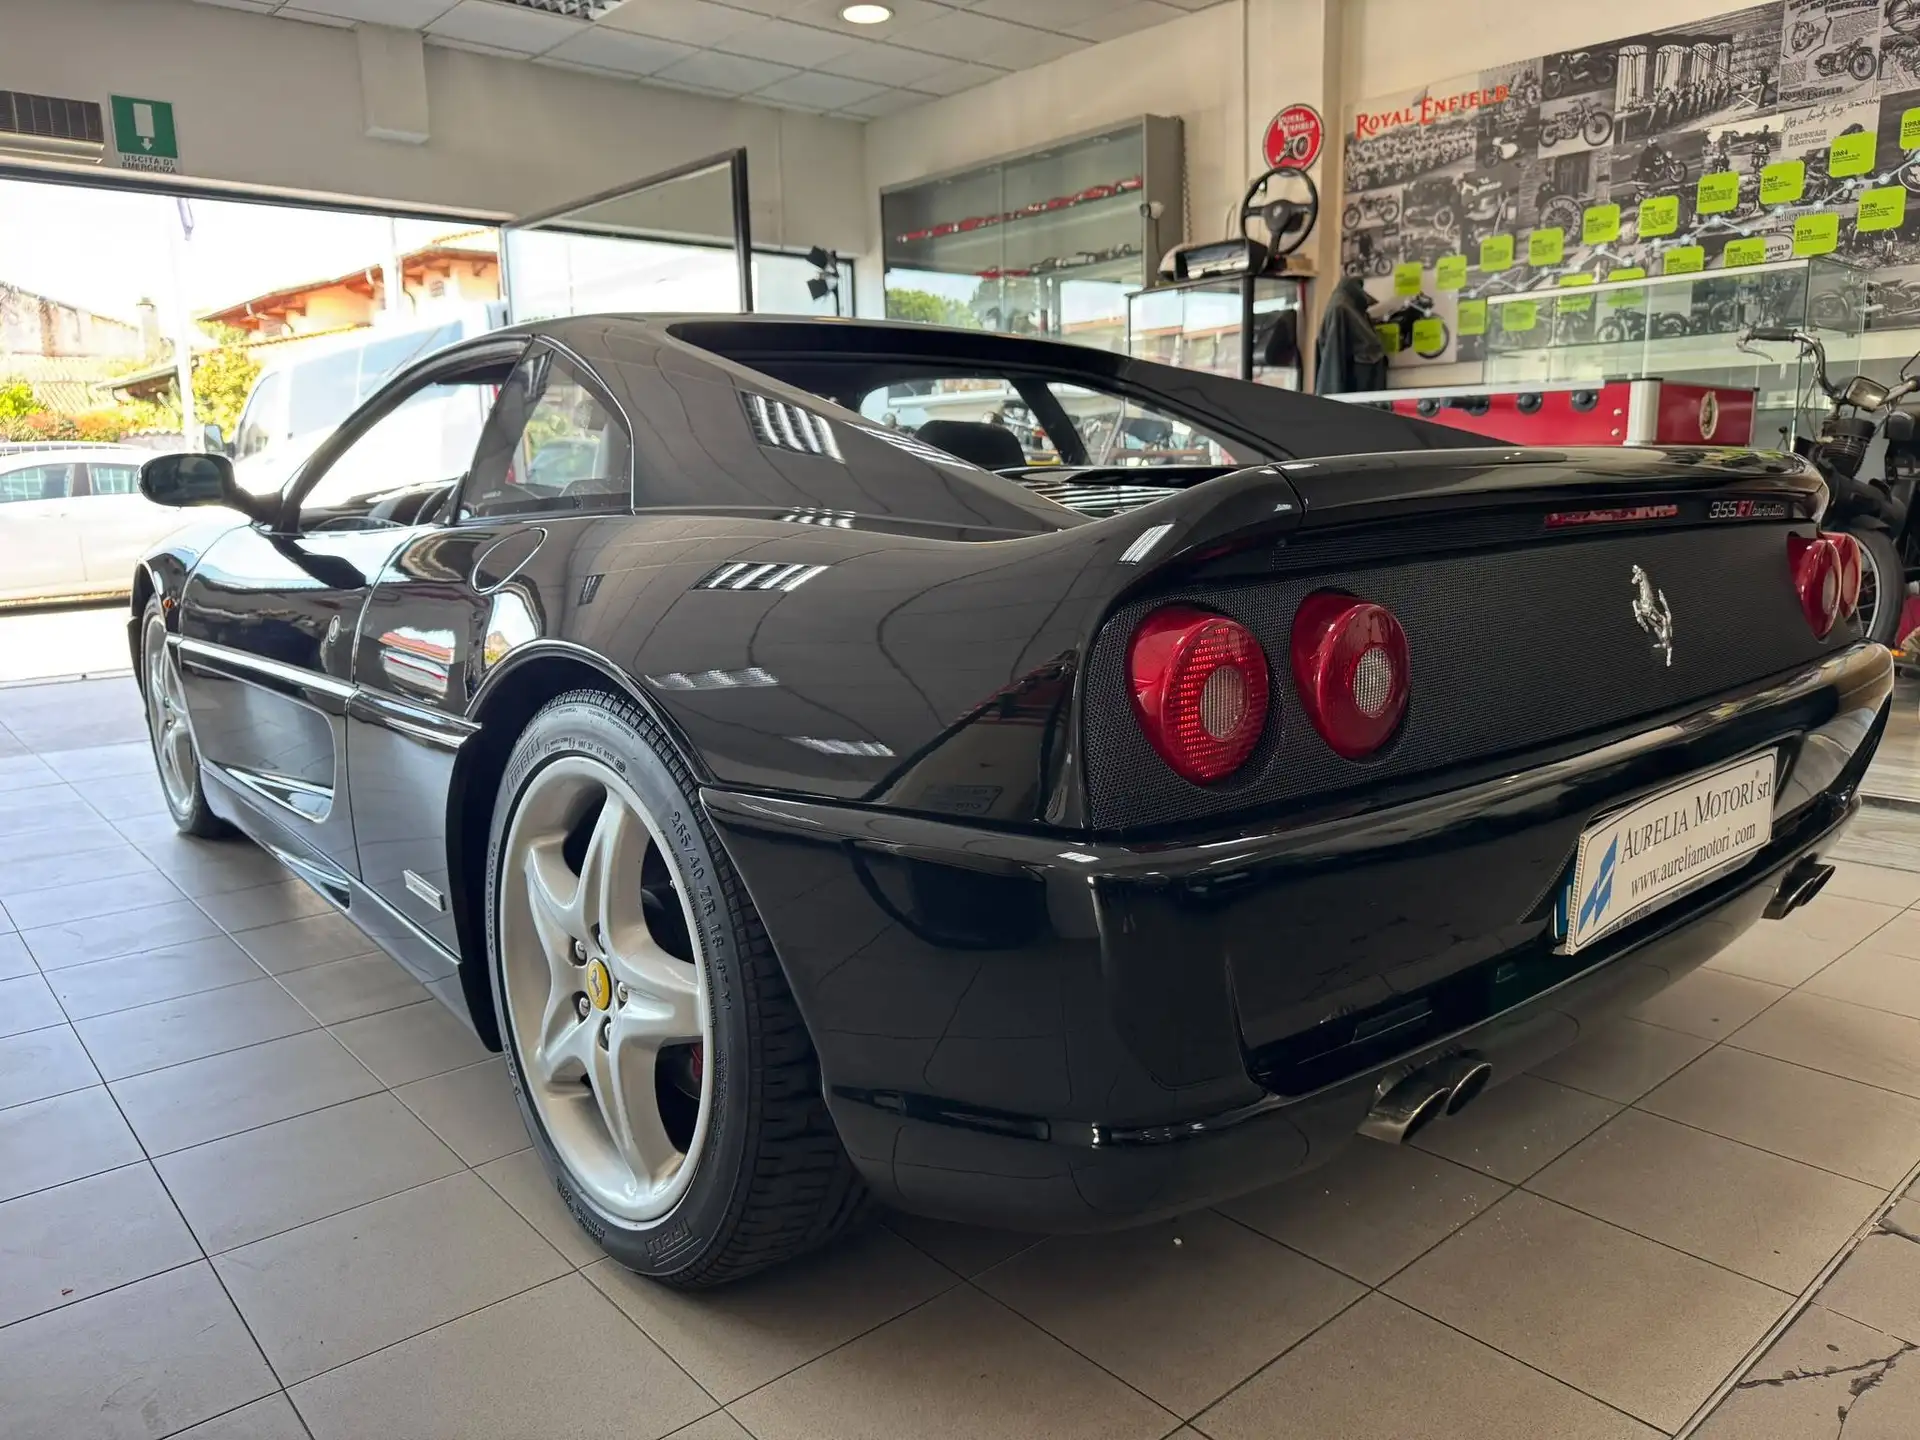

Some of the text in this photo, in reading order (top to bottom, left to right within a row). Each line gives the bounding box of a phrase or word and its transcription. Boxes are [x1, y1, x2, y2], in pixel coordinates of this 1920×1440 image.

[1355, 84, 1509, 139] ROYAL ENFIELD
[121, 161, 177, 174] EMERGENZA
[124, 154, 174, 167] USCITA DI
[1620, 773, 1772, 865] AURELIA MOTORI srl
